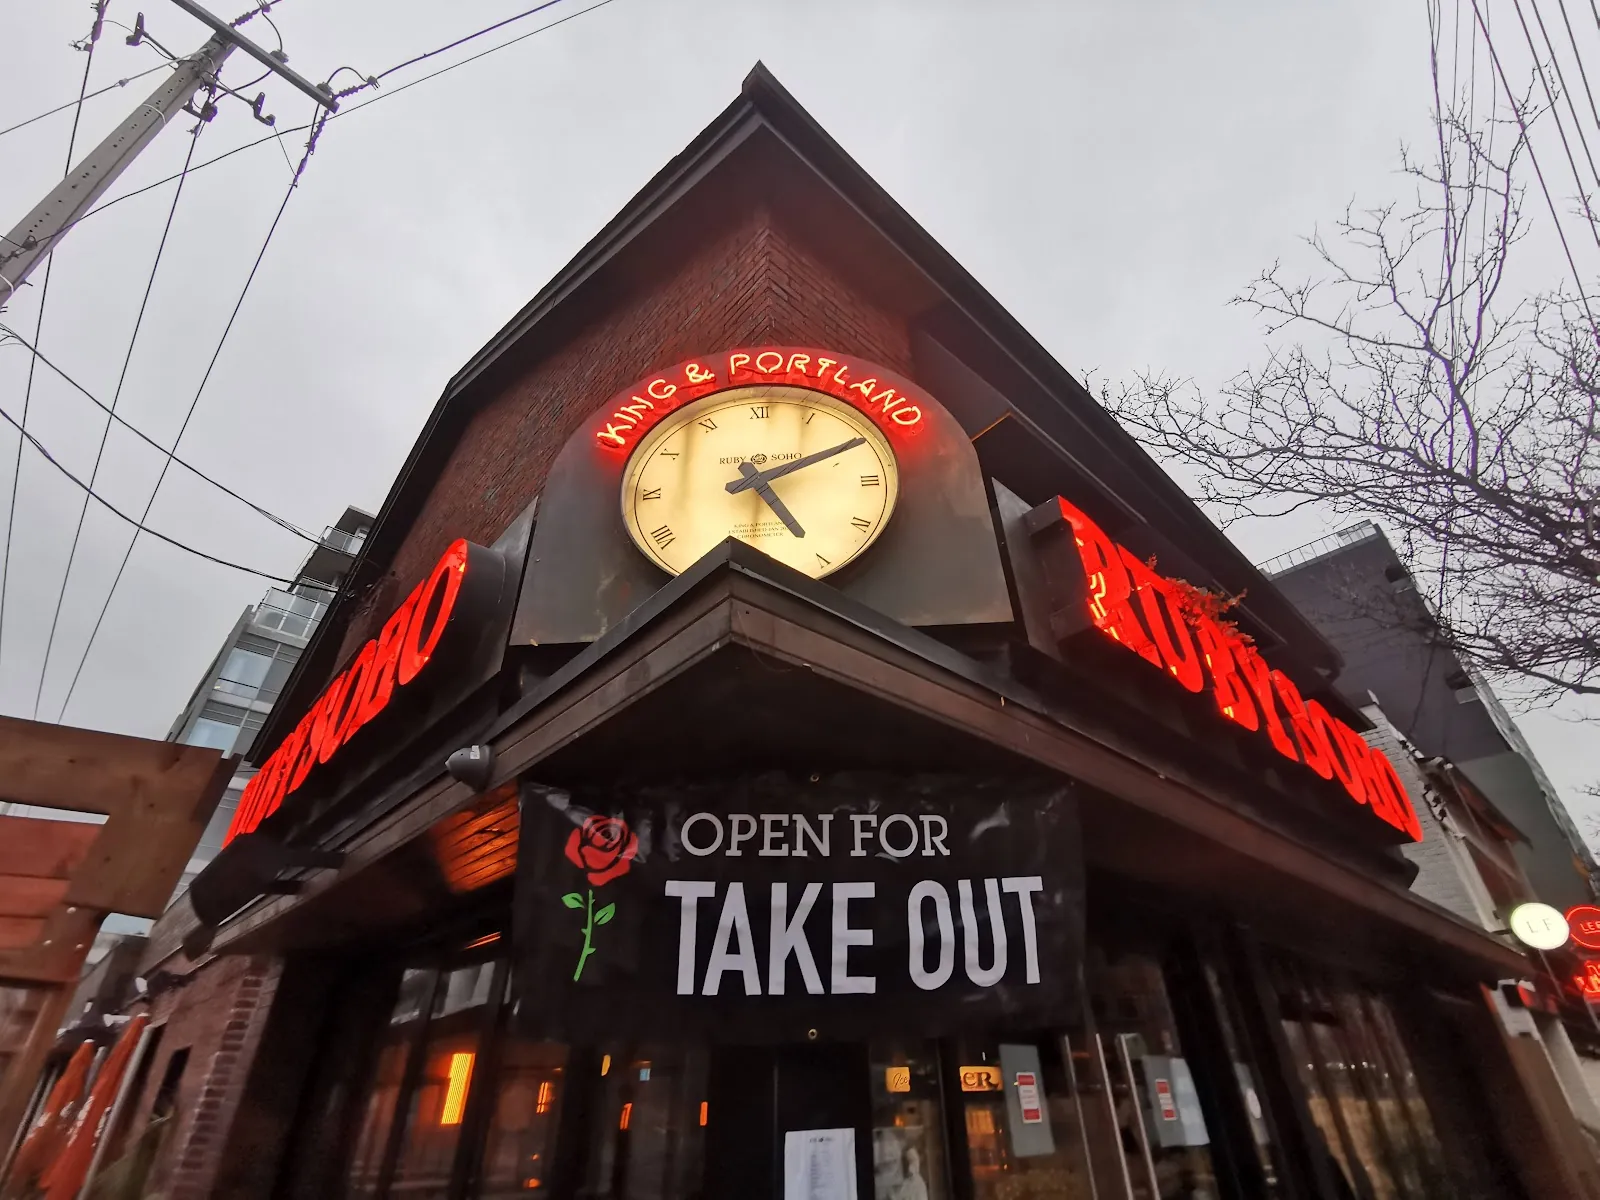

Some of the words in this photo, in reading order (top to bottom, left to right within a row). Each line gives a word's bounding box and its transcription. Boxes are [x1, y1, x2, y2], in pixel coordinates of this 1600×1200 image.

[597, 379, 677, 445] KING
[685, 363, 716, 384] &
[730, 351, 922, 426] PORTLAND
[750, 405, 770, 420] XII
[719, 456, 746, 465] RUBY
[771, 451, 802, 461] SOHO
[681, 812, 833, 857] OPEN
[850, 813, 951, 857] FOR
[665, 880, 877, 996] TAKE
[908, 876, 1043, 991] OUT
